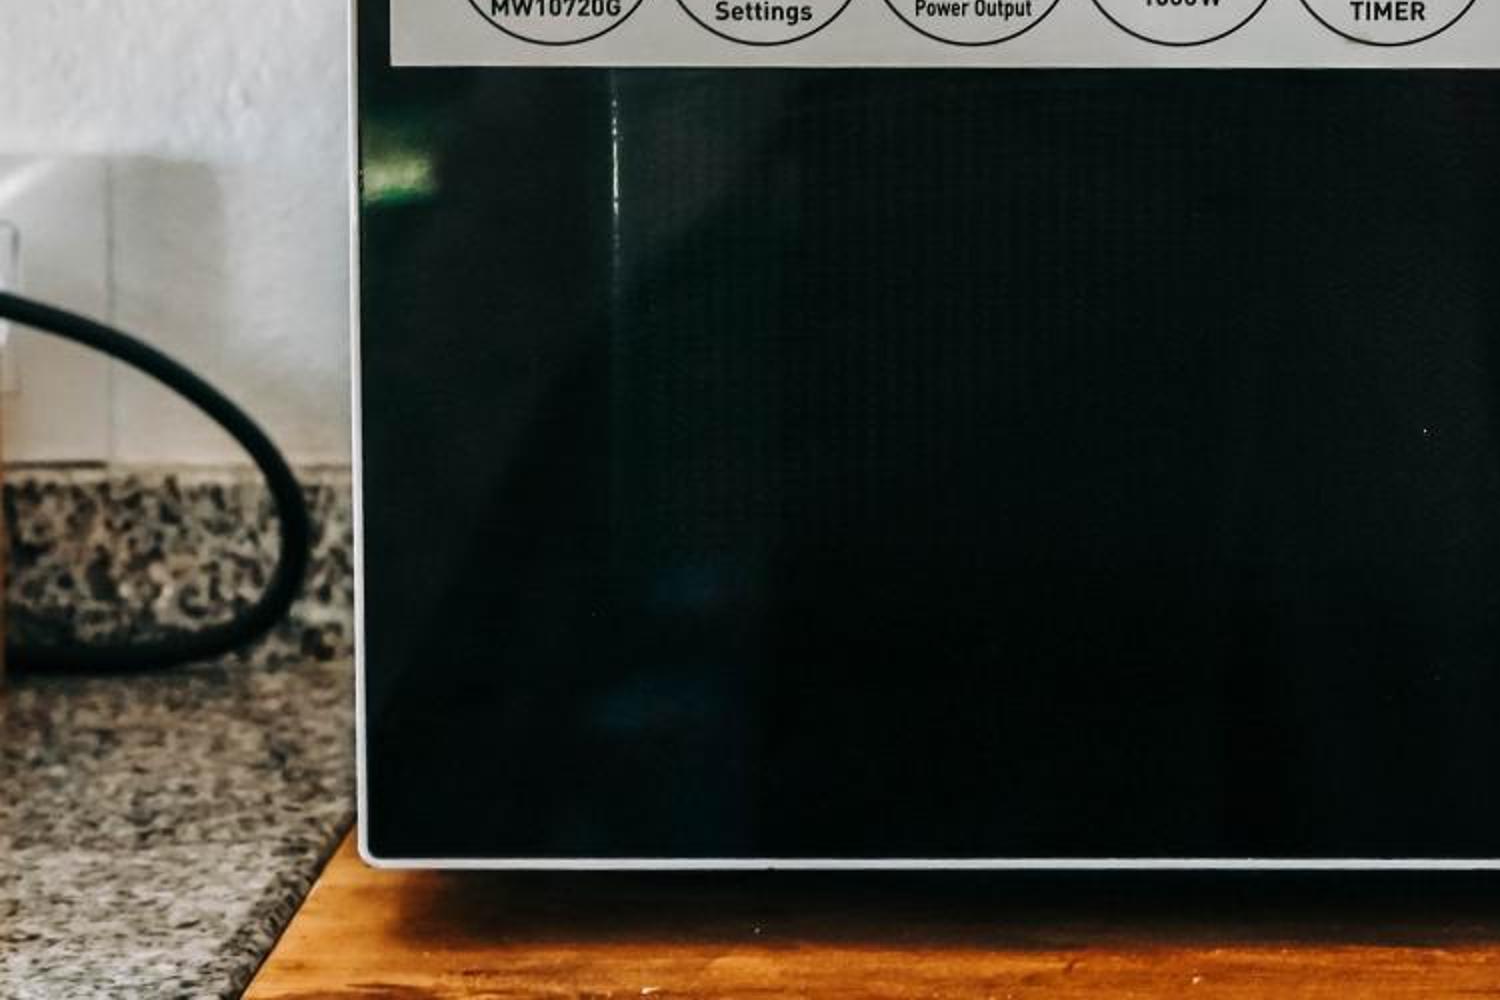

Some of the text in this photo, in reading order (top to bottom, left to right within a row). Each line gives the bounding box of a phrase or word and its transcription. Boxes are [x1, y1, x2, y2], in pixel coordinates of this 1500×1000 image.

[715, 1, 813, 26] Settings
[915, 0, 1032, 19] Power Output
[1350, 1, 1426, 21] TIMER
